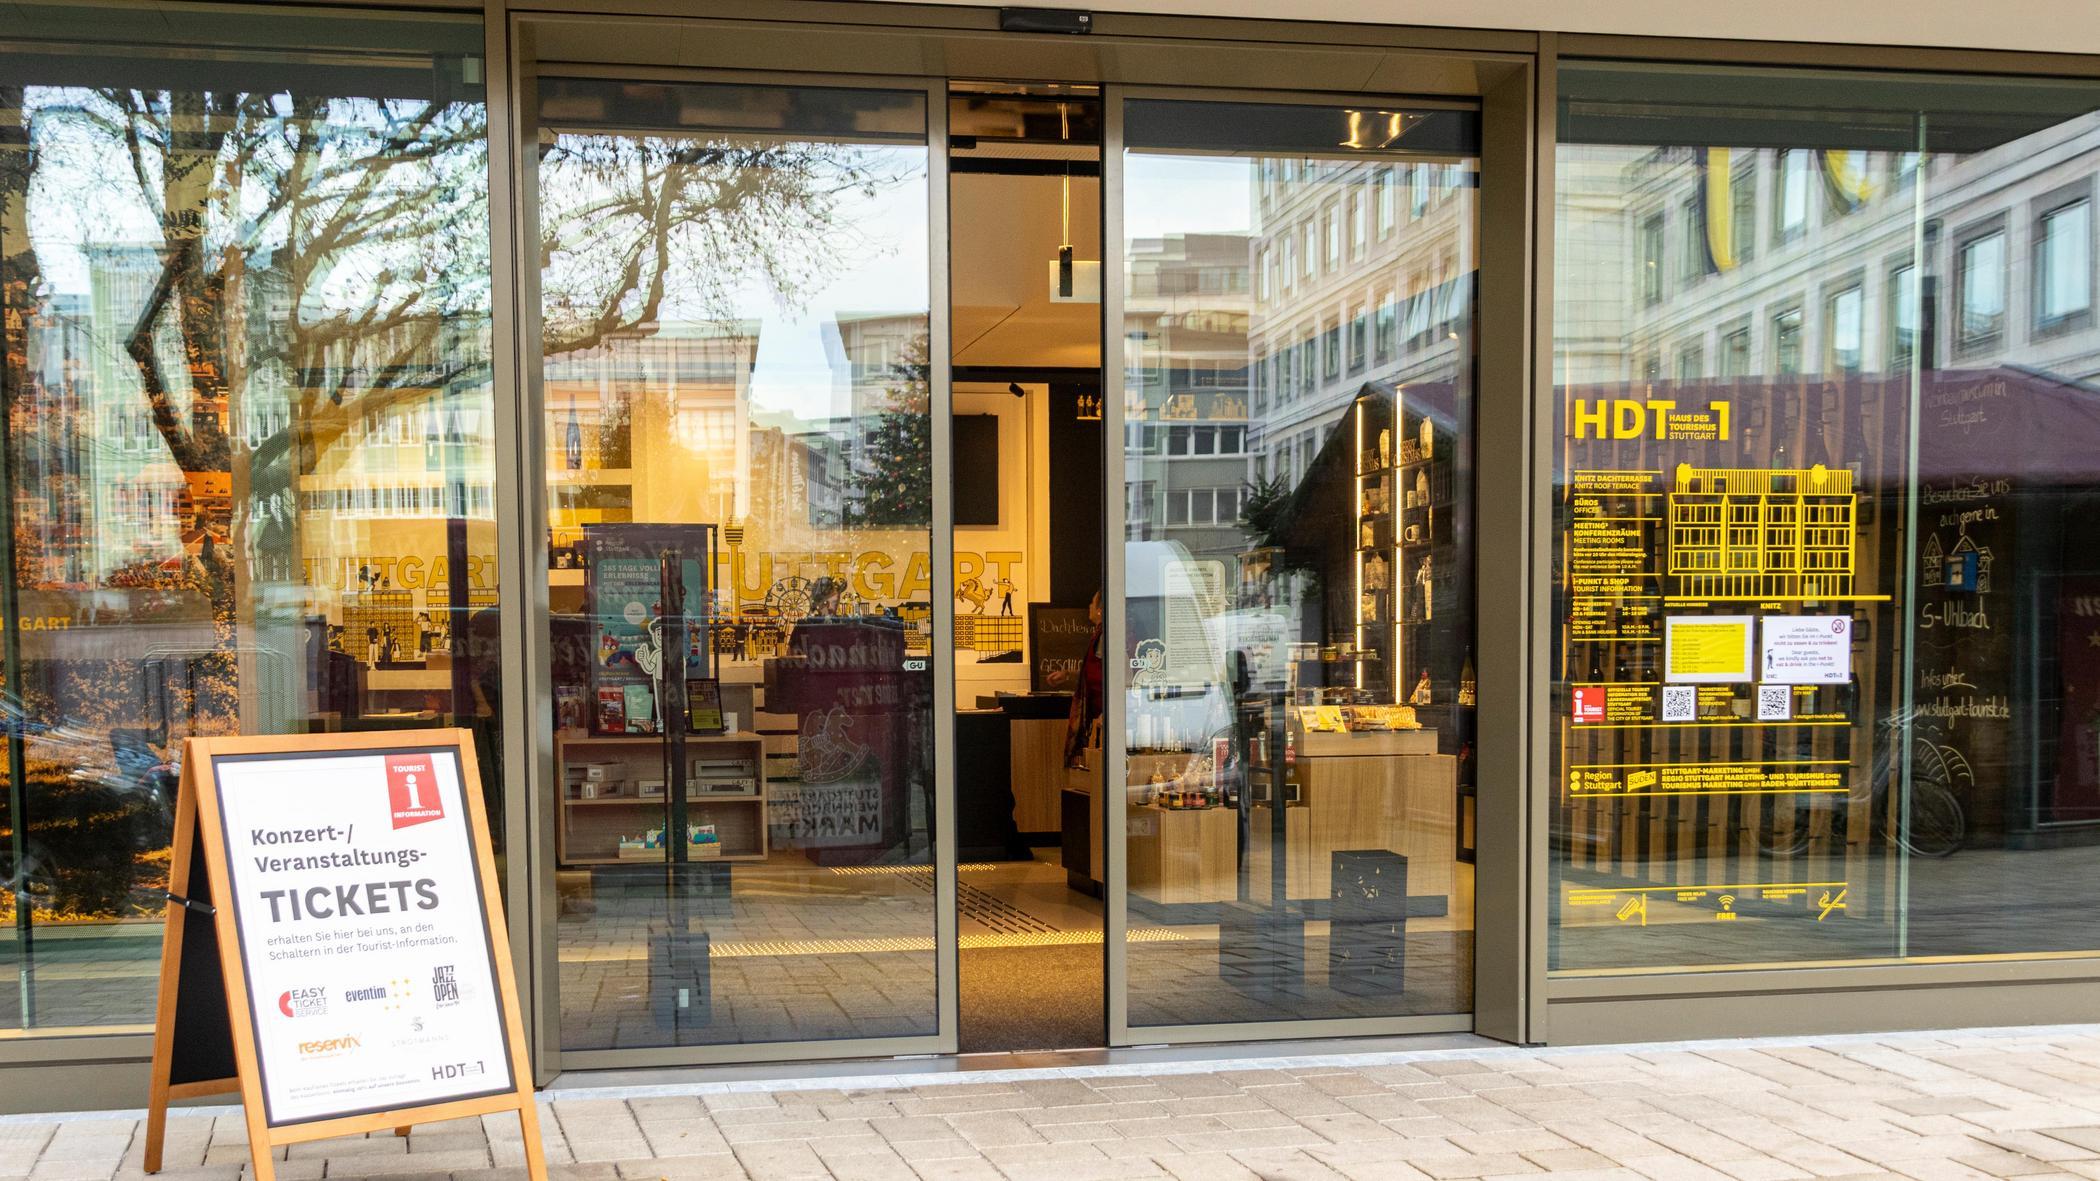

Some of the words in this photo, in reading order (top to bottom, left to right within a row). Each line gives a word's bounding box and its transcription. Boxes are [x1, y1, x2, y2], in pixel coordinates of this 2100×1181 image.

[1574, 399, 1676, 440] HDT
[1669, 414, 1691, 422] HAUS
[1693, 414, 1709, 422] DES
[1669, 423, 1716, 431] TOURISMUS
[1669, 432, 1716, 440] STUTTGART
[1597, 475, 1653, 483] DACHTERRASSE
[1574, 497, 1598, 506] BÜROS
[1574, 528, 1641, 537] KONFERENZRÄUME
[1760, 602, 1782, 610] KNITZ
[19, 616, 72, 630] GART
[392, 764, 426, 773] TOURIST
[1661, 767, 1744, 775] STUTTGART-MARKETING
[1584, 771, 1613, 781] Region
[1584, 781, 1622, 791] Stuttgart
[1761, 779, 1839, 788] BADEN-WÜRTTEMBERG
[393, 809, 441, 818] INFORMATION
[251, 824, 353, 846] Konzert-/
[254, 848, 427, 873] Veranstaltungs-
[260, 878, 440, 923] TICKETS
[1716, 912, 1736, 920] FREE
[267, 934, 313, 946] erhalten
[315, 931, 331, 942] Sie
[334, 929, 354, 940] hier
[357, 927, 373, 937] bei
[376, 927, 397, 937] uns,
[400, 925, 412, 934] an
[415, 922, 434, 933] den
[269, 947, 321, 961] Schaltern
[323, 945, 334, 955] in
[336, 944, 353, 954] der
[356, 935, 458, 952] Tourist-Information.
[432, 965, 457, 985] JAZZ
[292, 986, 326, 1000] EASY
[345, 986, 387, 1002] eventim
[434, 982, 459, 1002] OPEN
[294, 997, 328, 1009] TICKET
[298, 1033, 361, 1054] reservix
[431, 1063, 467, 1080] HDT
